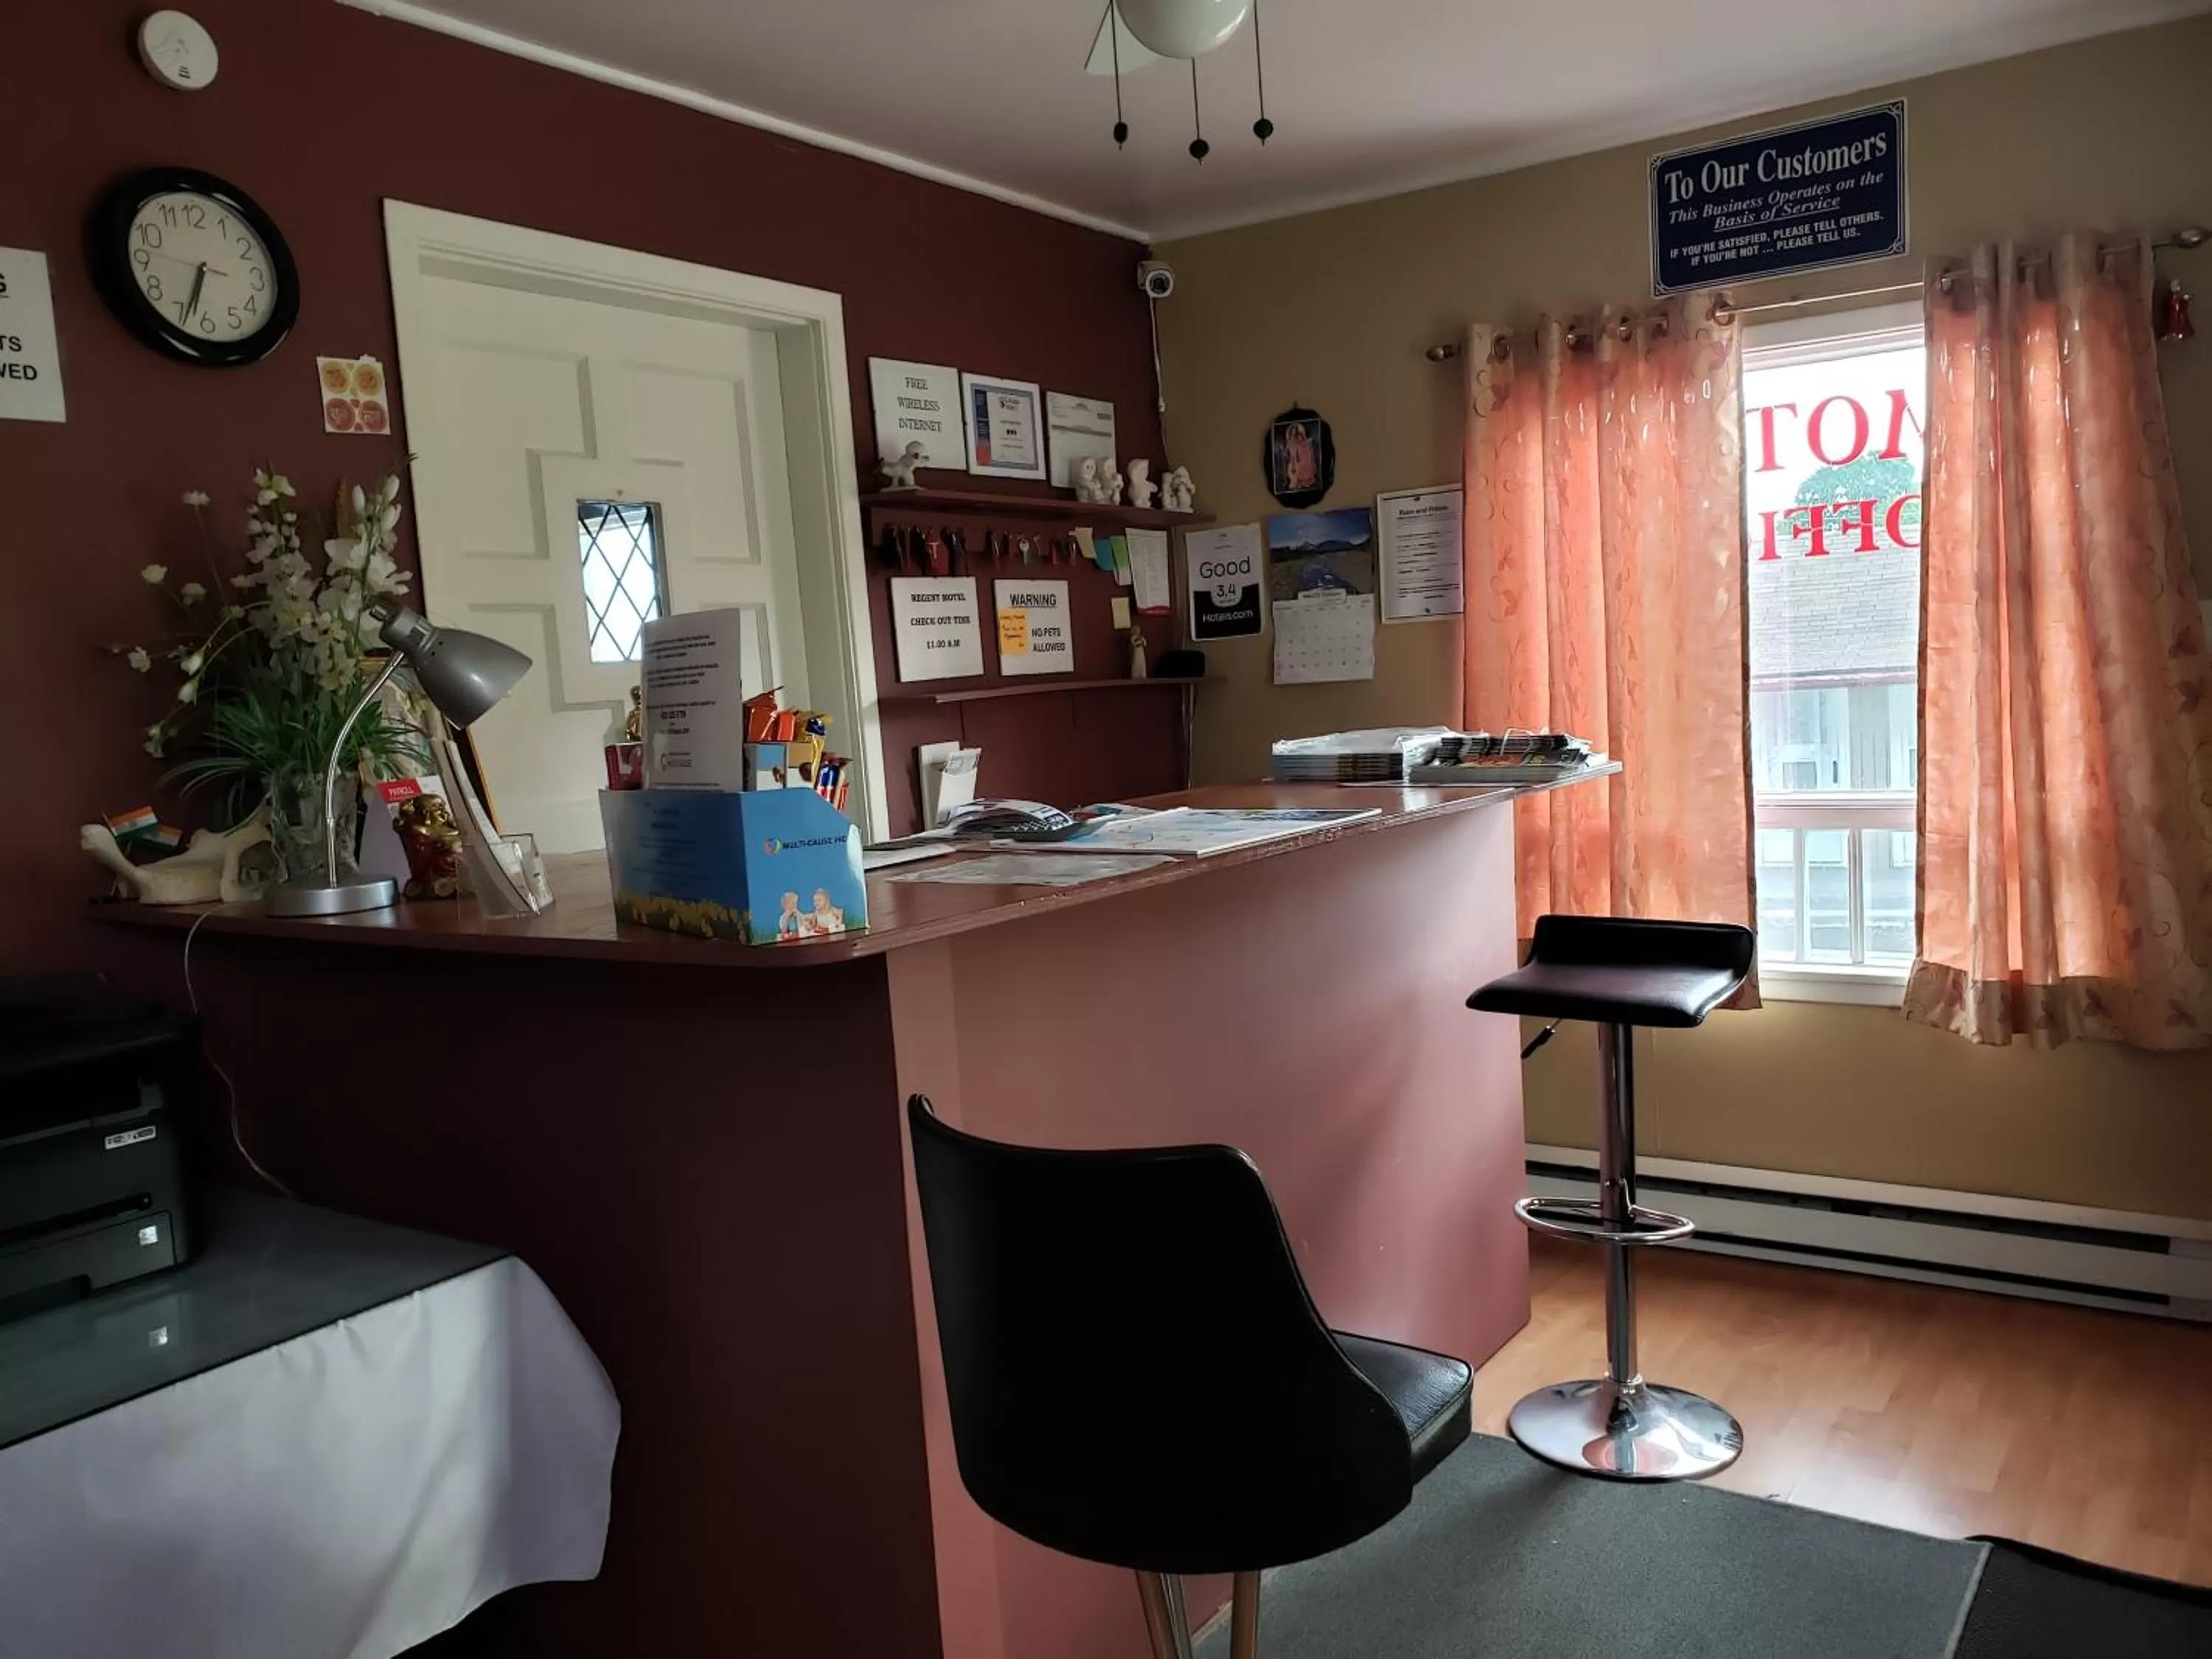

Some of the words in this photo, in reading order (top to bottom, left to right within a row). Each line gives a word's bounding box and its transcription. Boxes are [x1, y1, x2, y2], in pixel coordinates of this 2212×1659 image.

[1664, 170, 1694, 204] To
[1701, 160, 1750, 193] Our
[1757, 132, 1888, 183] Customers
[1669, 206, 1698, 224] This
[1703, 197, 1764, 218] Business
[1768, 183, 1832, 205] Operates
[1835, 178, 1855, 192] on
[1860, 170, 1884, 187] the
[159, 204, 177, 228] 11
[181, 204, 206, 230] 12
[1714, 211, 1756, 229] Basis
[1761, 204, 1781, 221] of
[1781, 197, 1840, 216] Service
[136, 223, 161, 248] 10
[218, 218, 226, 240] 1
[1670, 248, 1680, 259] IF
[1682, 241, 1716, 256] YOU'RE
[1718, 232, 1770, 250] SATISFIED,
[1773, 223, 1811, 239] PLEASE
[1813, 218, 1837, 232] TELL
[1840, 211, 1885, 226] OTHERS.
[236, 237, 252, 261] 2
[1691, 256, 1700, 266] IF
[1703, 249, 1737, 264] YOU'RE
[1739, 245, 1759, 257] NOT
[1776, 235, 1814, 251] PLEASE
[1816, 230, 1840, 243] TELL
[1843, 227, 1862, 239] US.
[133, 248, 150, 272] 9
[147, 275, 162, 302] 8
[249, 266, 265, 292] 3
[171, 300, 184, 324] 7
[243, 294, 257, 316] 4
[200, 310, 215, 334] 6
[228, 306, 242, 330] 5
[905, 377, 929, 390] FREE
[897, 396, 941, 412] WIRELESS
[898, 418, 943, 432] INTERNET
[1200, 555, 1251, 579] Good
[911, 593, 940, 602] REGENT
[942, 592, 966, 602] MOTEL
[1009, 592, 1057, 606] WARNING
[1217, 583, 1237, 598] 3.4
[911, 616, 936, 626] CHECK
[937, 616, 951, 625] OUT
[1032, 627, 1043, 638] NO
[1044, 627, 1062, 637] PETS
[1033, 642, 1066, 653] ALLOWED
